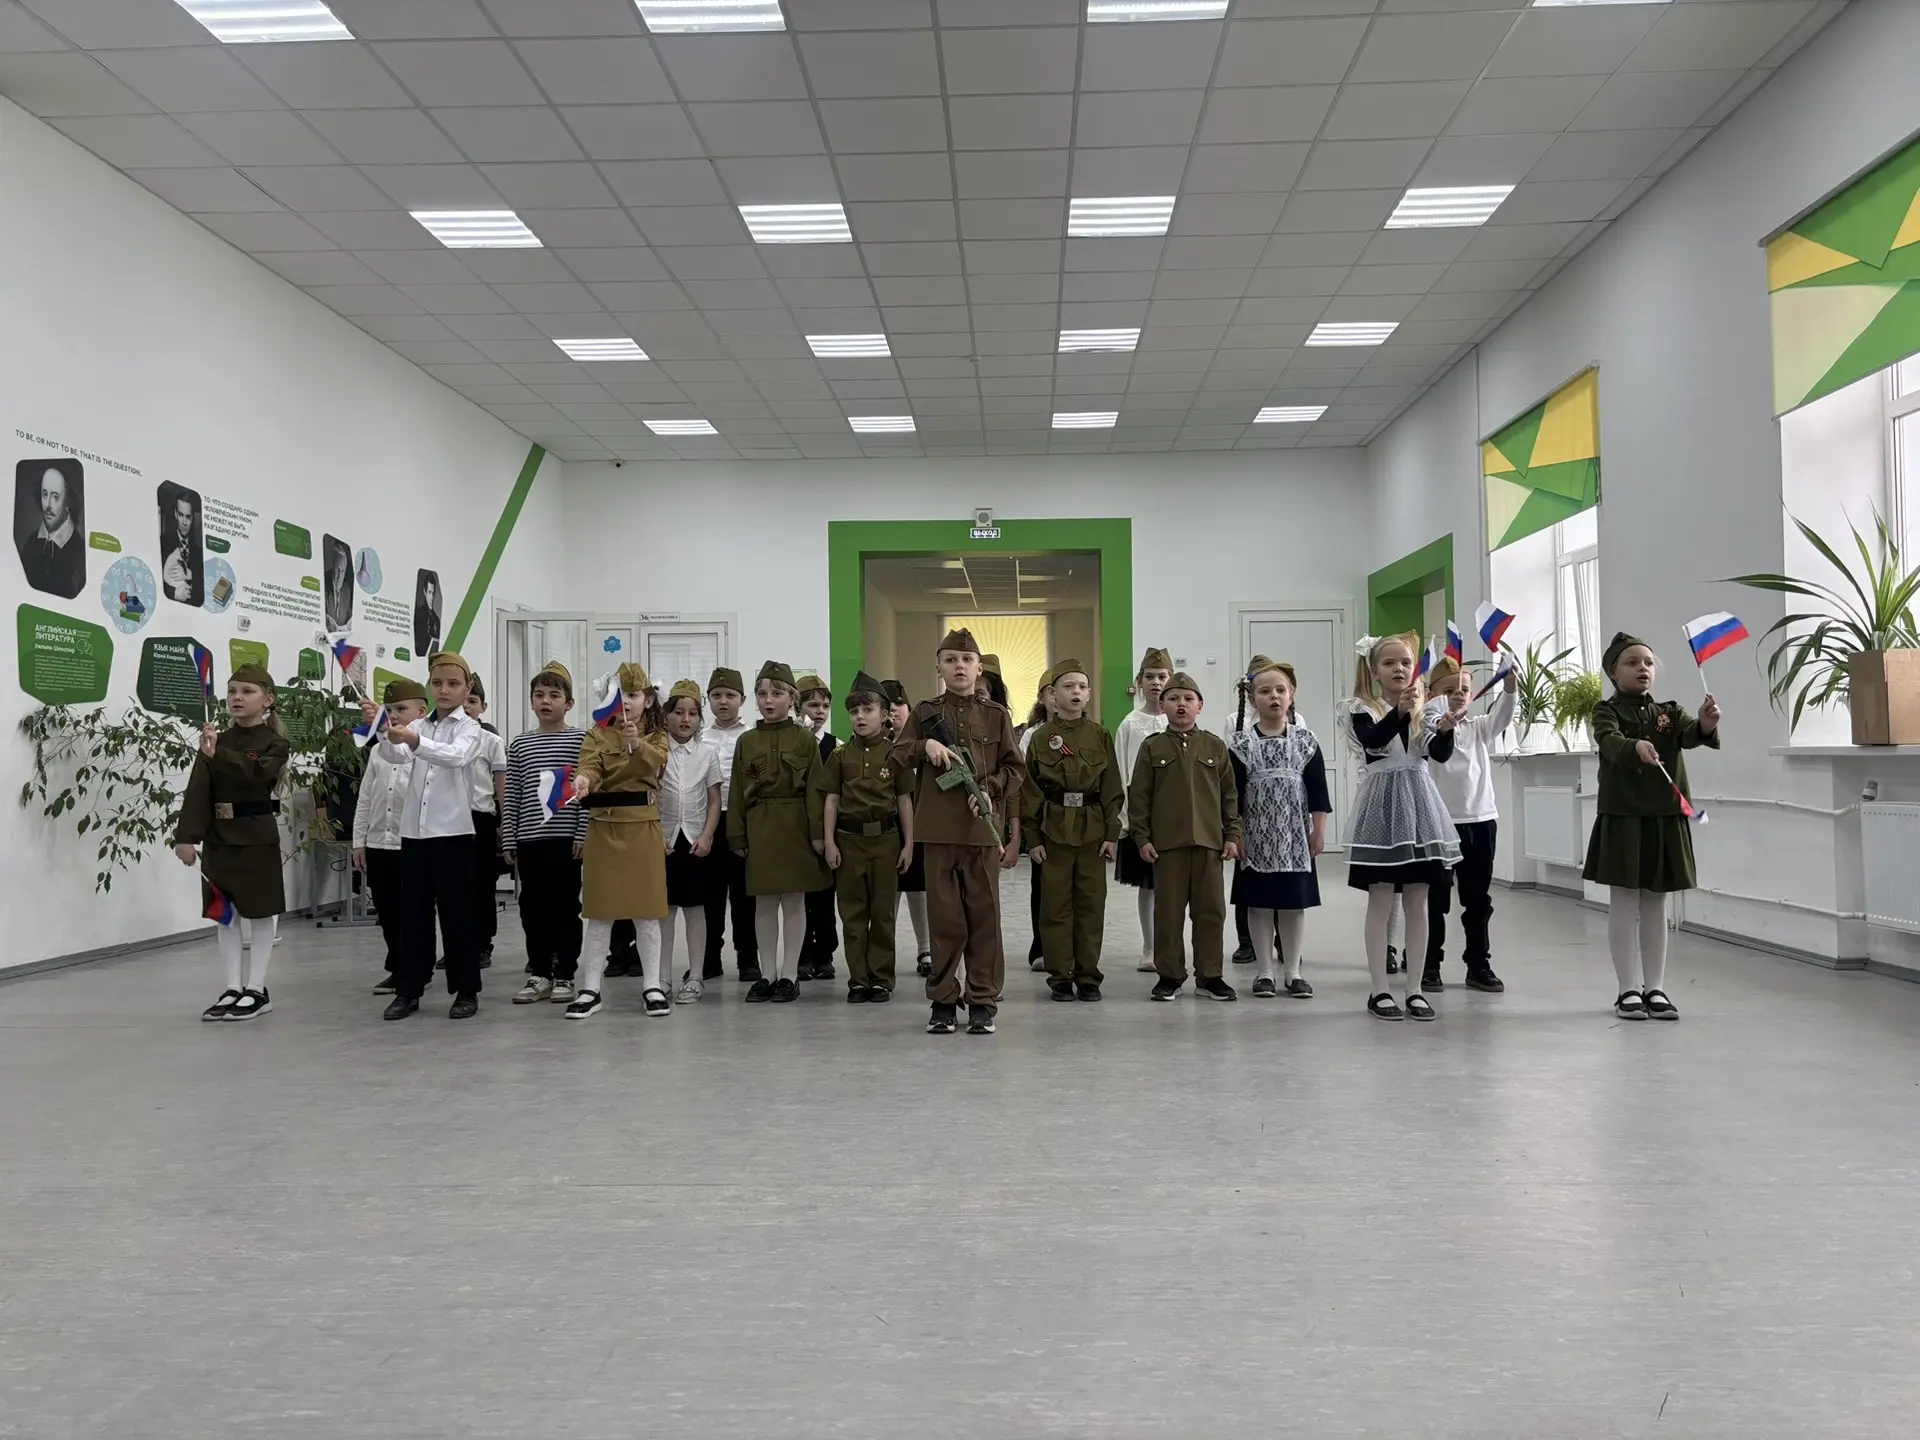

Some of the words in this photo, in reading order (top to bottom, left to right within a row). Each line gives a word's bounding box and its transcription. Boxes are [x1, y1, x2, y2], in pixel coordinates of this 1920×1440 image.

[15, 429, 24, 438] TO
[26, 432, 35, 443] BE,
[36, 436, 45, 445] OR
[46, 439, 59, 450] NOT
[61, 444, 69, 453] TO
[70, 447, 79, 457] BE,
[79, 450, 95, 461] THAT
[103, 457, 113, 467] THE
[35, 624, 77, 636] АНГЛИЙСКАЯ
[35, 632, 75, 643] ЛИТЕРАТУРА
[153, 643, 168, 652] ЯЗЫК
